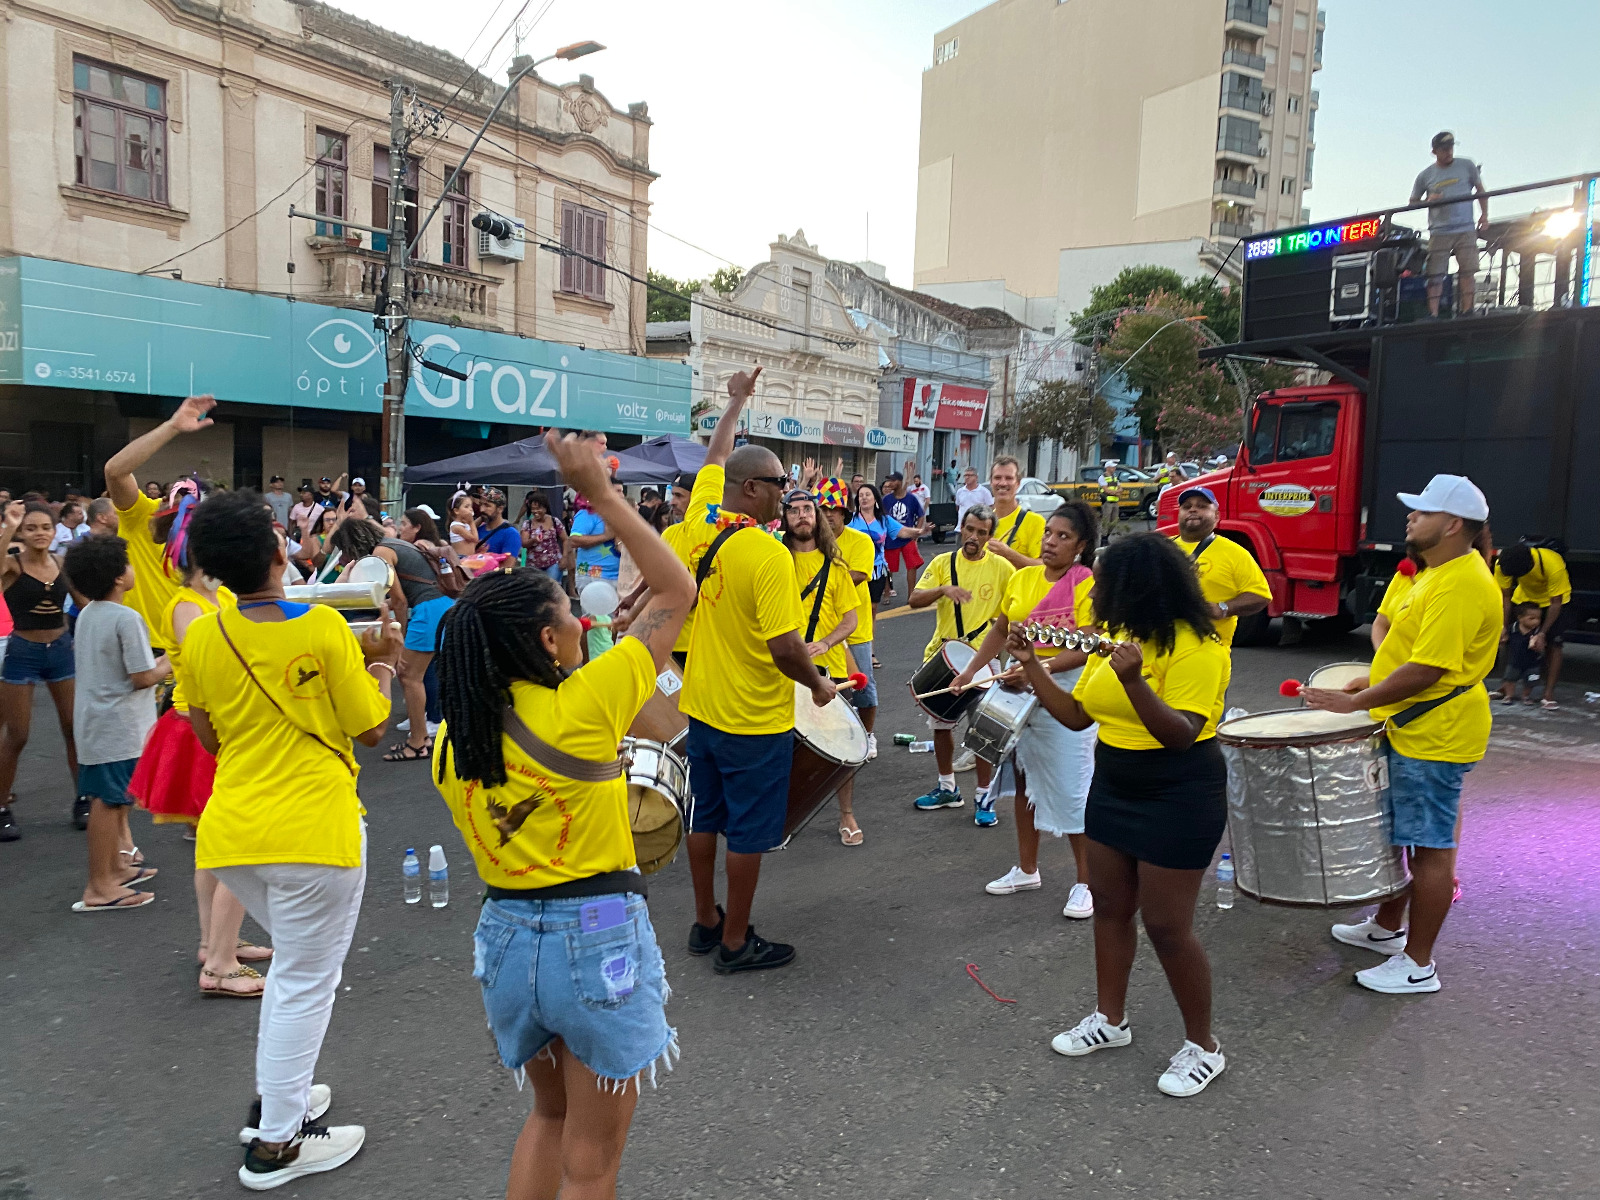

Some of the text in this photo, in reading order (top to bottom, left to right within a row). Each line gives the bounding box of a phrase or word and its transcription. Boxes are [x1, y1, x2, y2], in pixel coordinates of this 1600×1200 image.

[1287, 230, 1323, 251] TRIO
[69, 366, 136, 383] 3541.6574
[297, 369, 385, 398] óptic
[413, 334, 568, 419] Grazi
[616, 402, 648, 419] voltz
[1264, 492, 1311, 501] INTERPRISE
